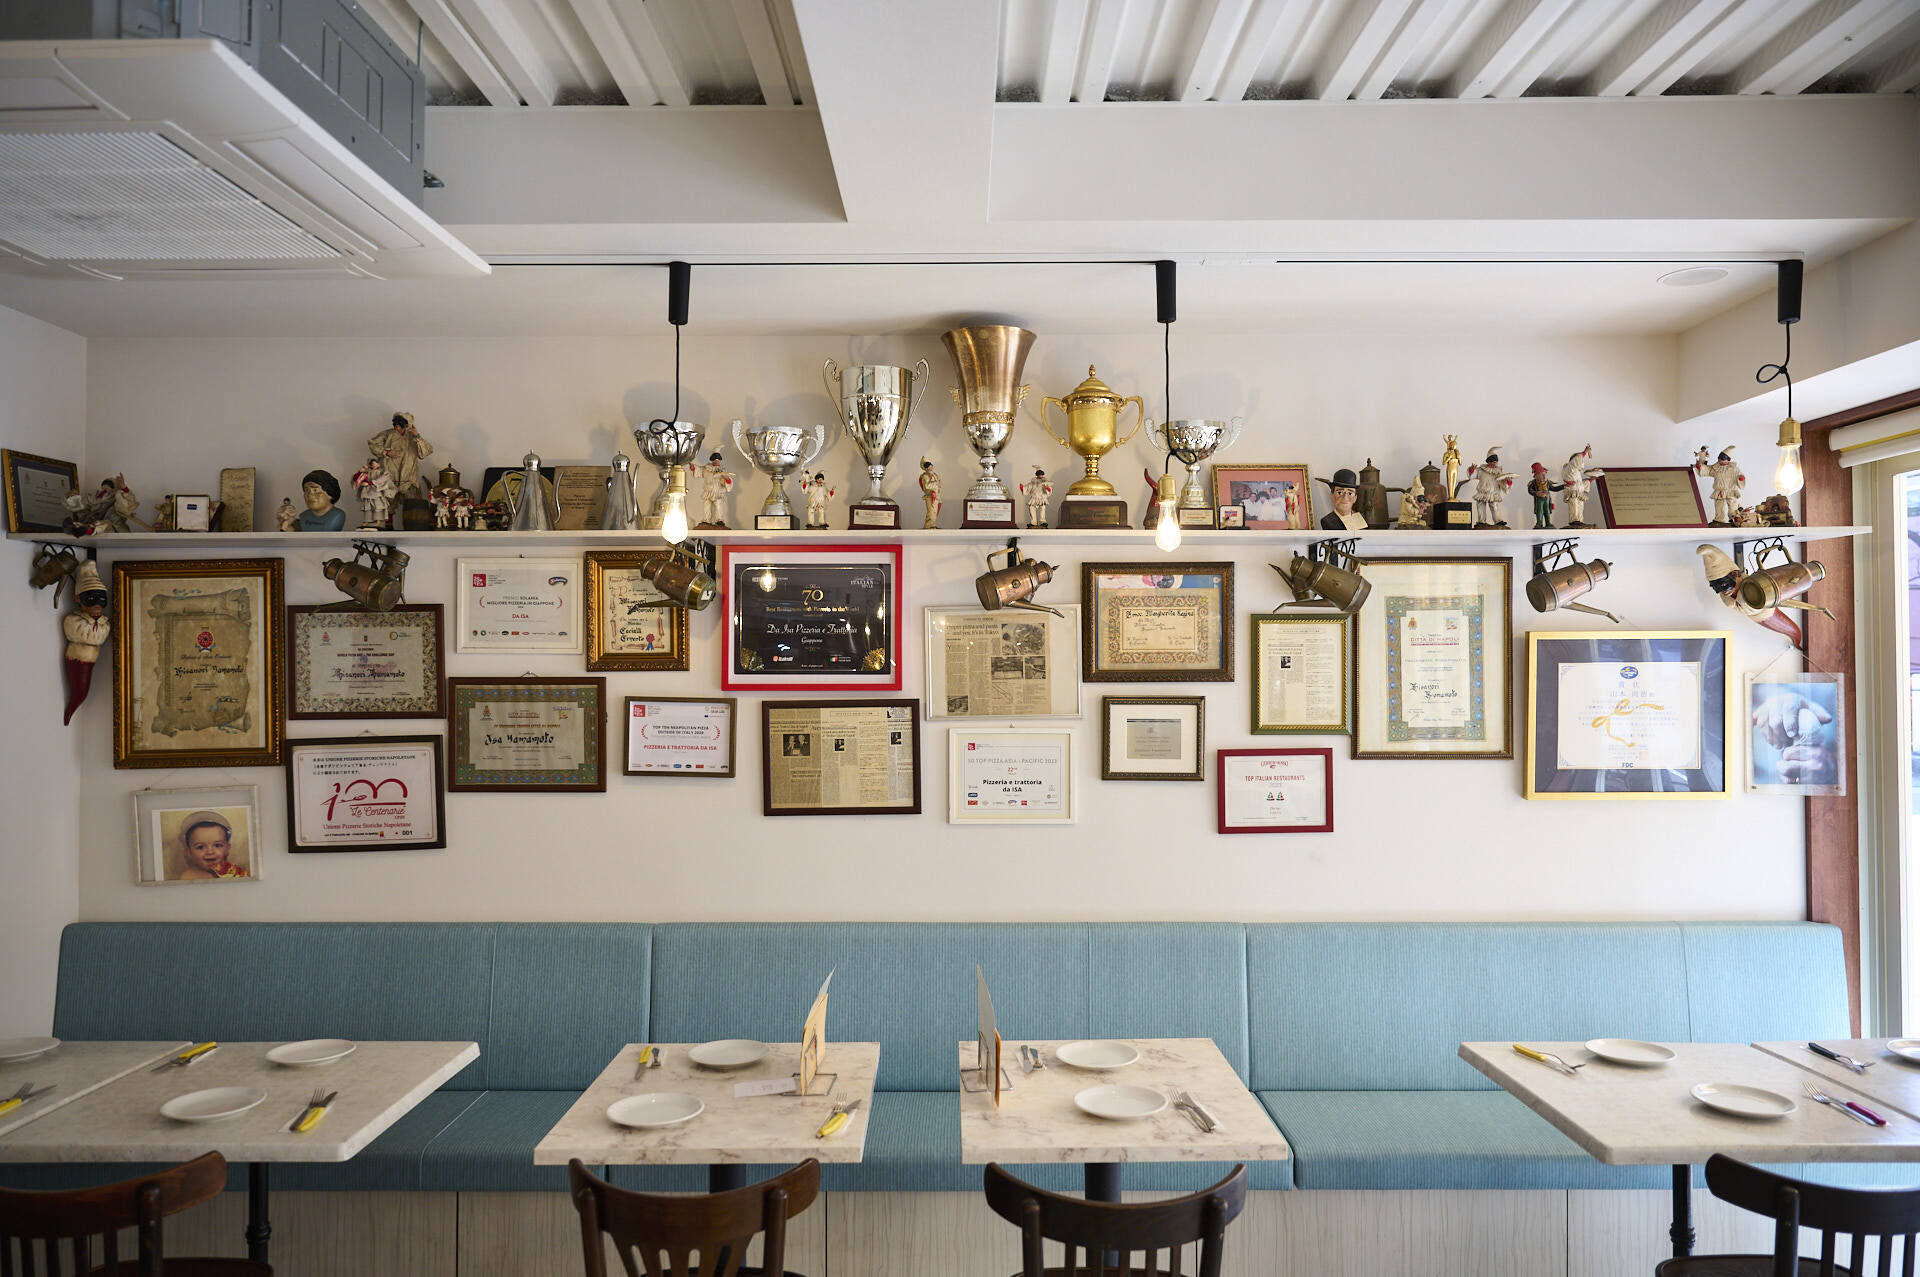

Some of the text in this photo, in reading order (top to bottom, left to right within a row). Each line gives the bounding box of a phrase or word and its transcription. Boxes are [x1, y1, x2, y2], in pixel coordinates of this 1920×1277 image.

[802, 588, 824, 606] 70
[766, 623, 780, 634] Da
[781, 623, 795, 634] Isa
[795, 623, 822, 634] Pizzeria
[507, 731, 555, 745] Yamamoto
[351, 806, 407, 818] Le Centenarie
[383, 820, 412, 829] Napoletane
